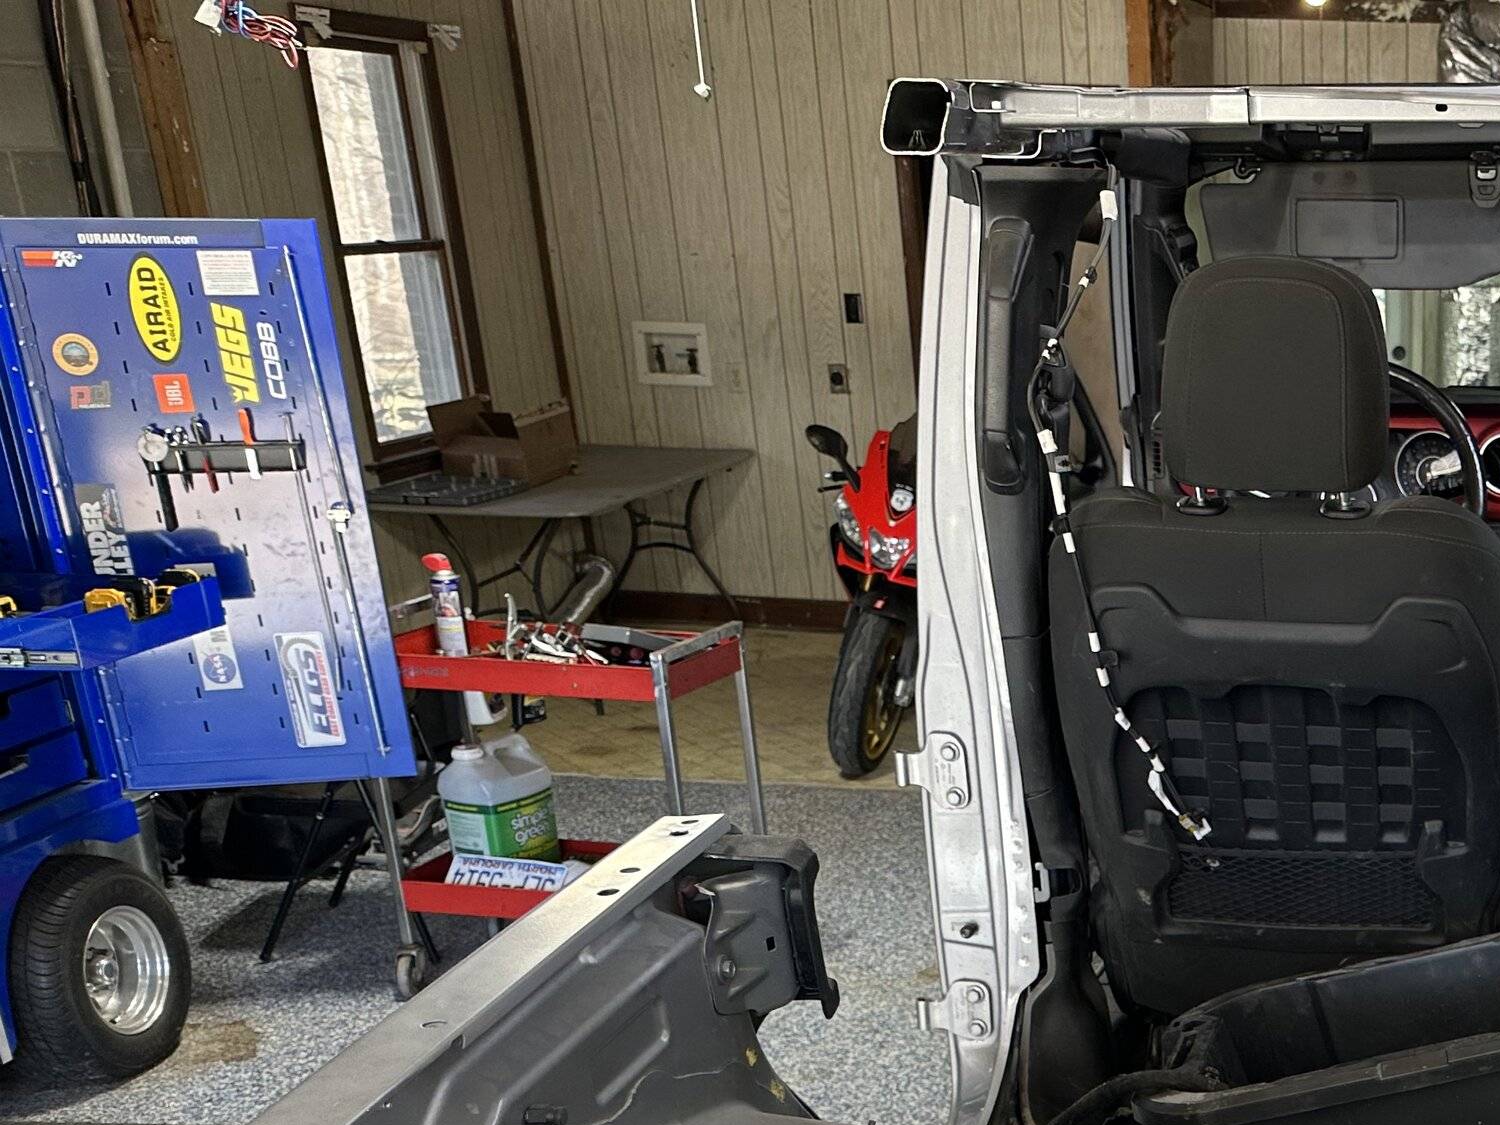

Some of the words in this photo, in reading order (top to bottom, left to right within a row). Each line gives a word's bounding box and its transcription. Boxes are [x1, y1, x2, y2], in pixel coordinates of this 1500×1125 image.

[77, 233, 198, 245] DURAMAXforum.com
[137, 267, 171, 353] AIRAID
[210, 302, 259, 402] JEGS
[256, 321, 287, 399] COBB
[164, 380, 184, 406] JBL
[213, 655, 228, 682] NASA
